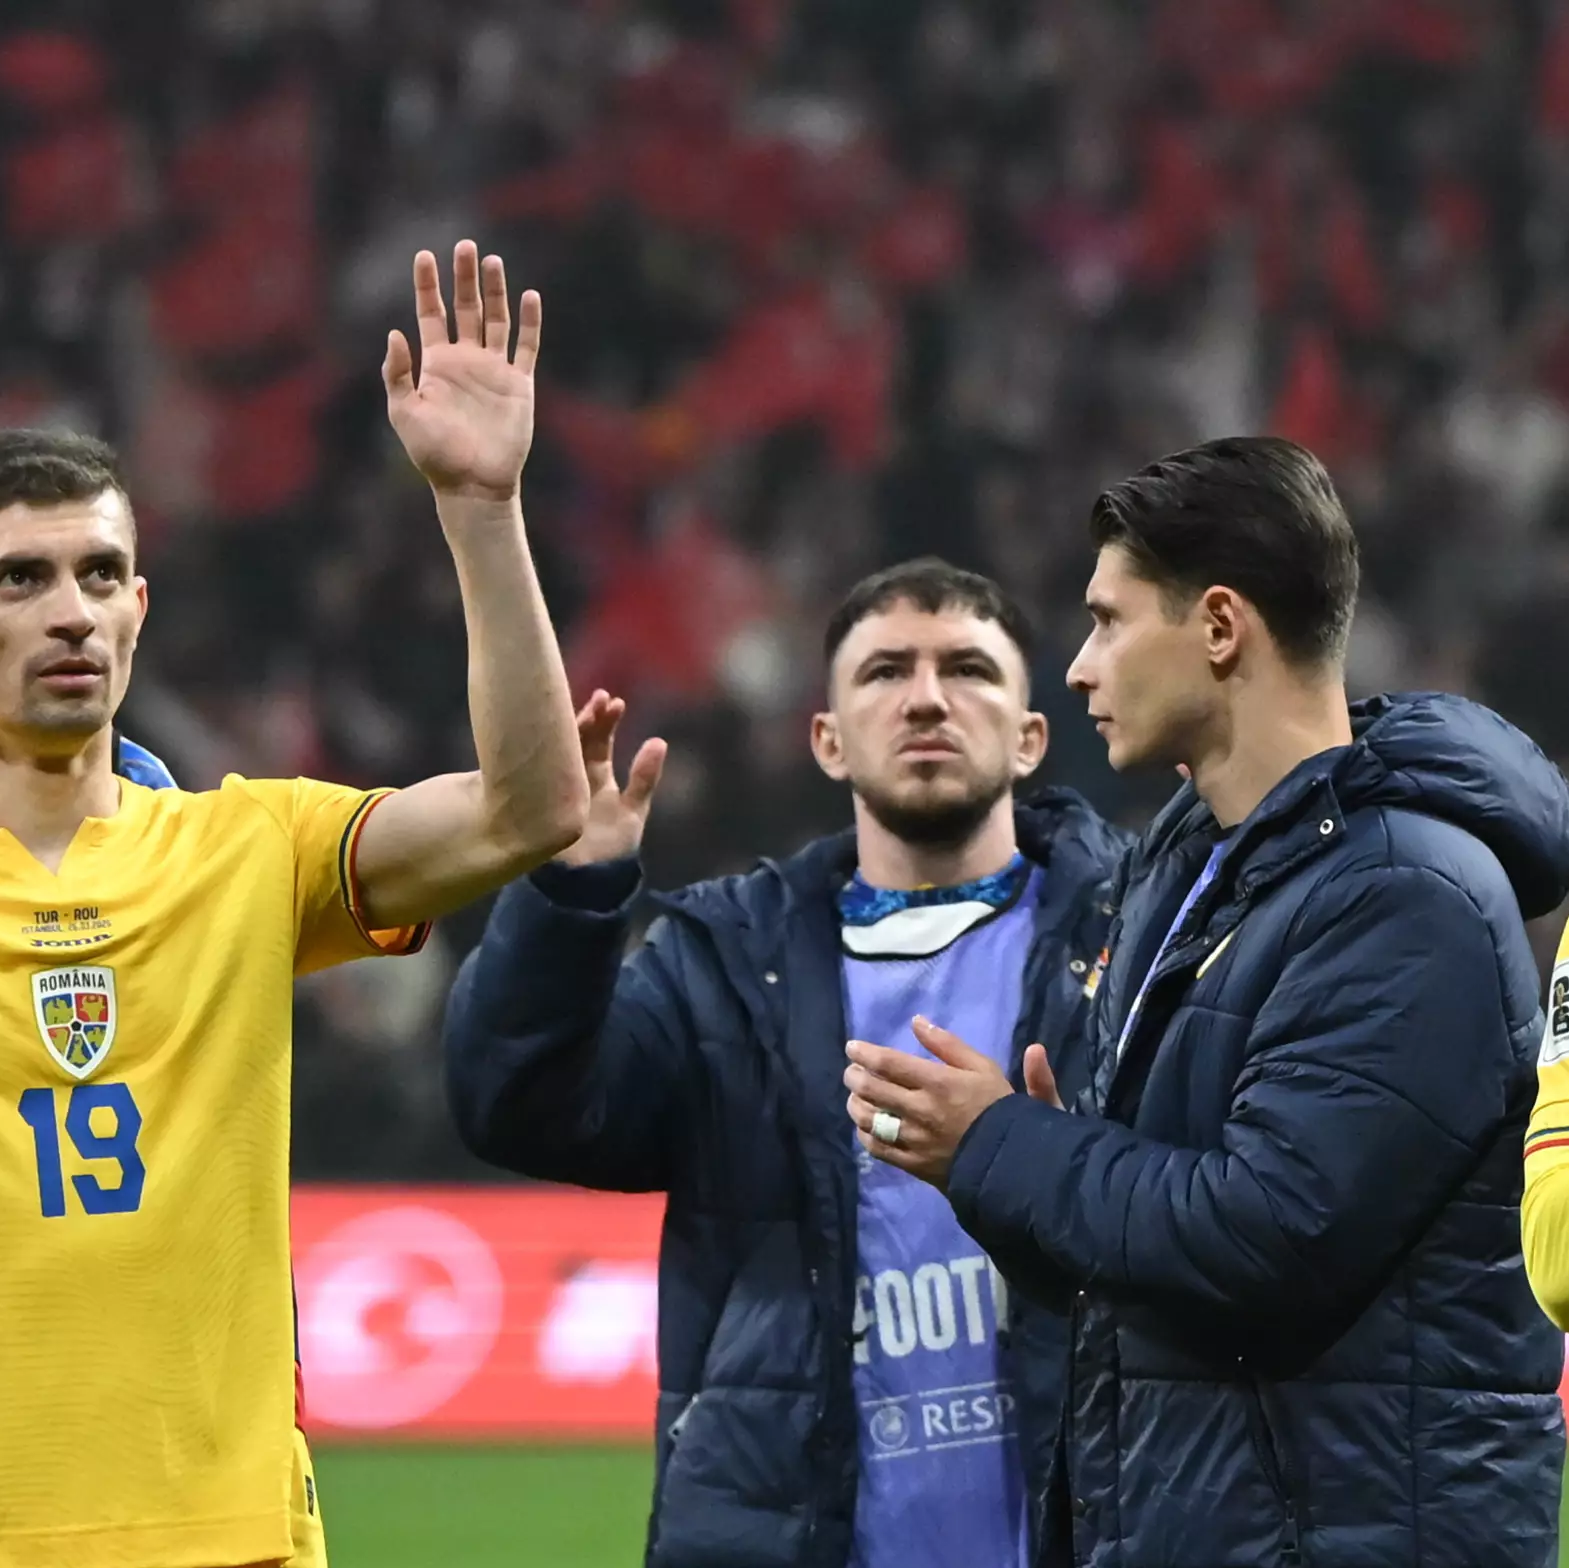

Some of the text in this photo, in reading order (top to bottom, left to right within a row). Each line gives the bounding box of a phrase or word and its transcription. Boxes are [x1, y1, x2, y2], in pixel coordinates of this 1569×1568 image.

[34, 910, 59, 924] TUR
[74, 907, 99, 920] ROU
[39, 968, 106, 993] ROMÂNIA
[18, 1083, 146, 1217] 19
